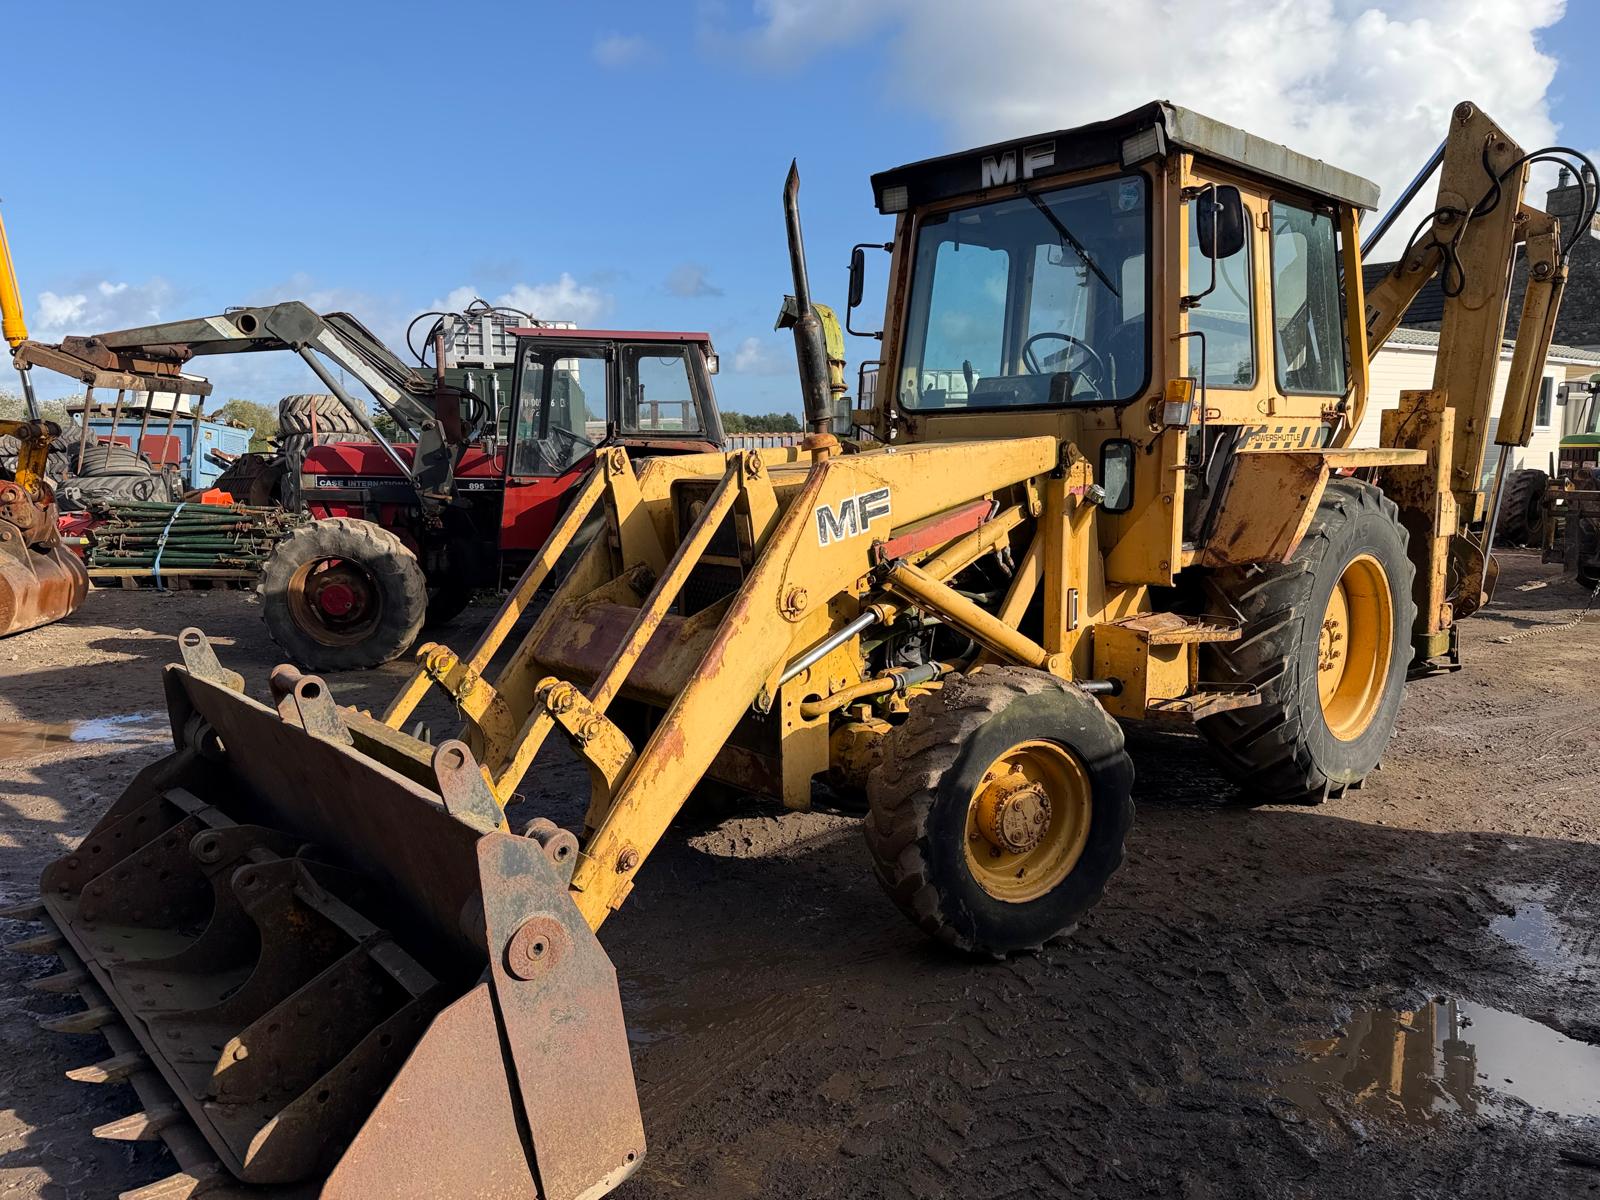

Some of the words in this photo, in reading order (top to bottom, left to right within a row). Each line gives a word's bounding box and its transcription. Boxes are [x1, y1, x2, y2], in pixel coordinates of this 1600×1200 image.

[981, 139, 1056, 188] MF
[1250, 433, 1301, 442] POWERSHUTTLE
[319, 479, 344, 487] CASE
[468, 482, 485, 490] 895
[815, 486, 892, 548] MF
